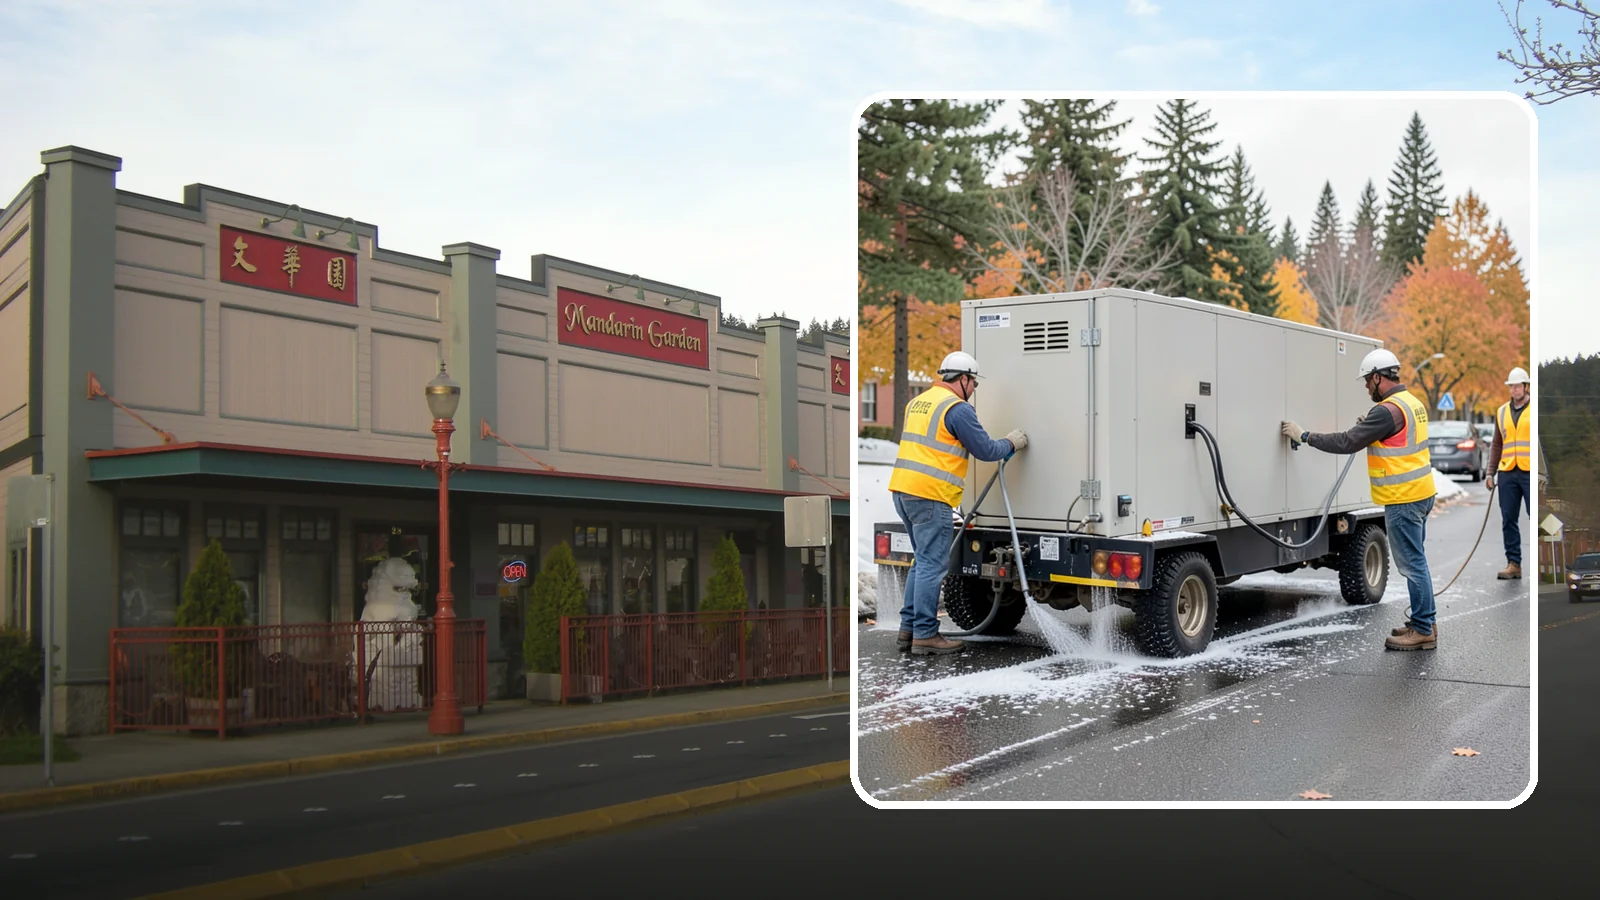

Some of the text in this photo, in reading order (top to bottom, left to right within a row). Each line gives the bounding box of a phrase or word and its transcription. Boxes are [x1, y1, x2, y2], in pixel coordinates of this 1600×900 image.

[231, 236, 346, 291] 文華園
[564, 302, 702, 353] Mandarin Garden
[503, 565, 527, 578] OPEN
